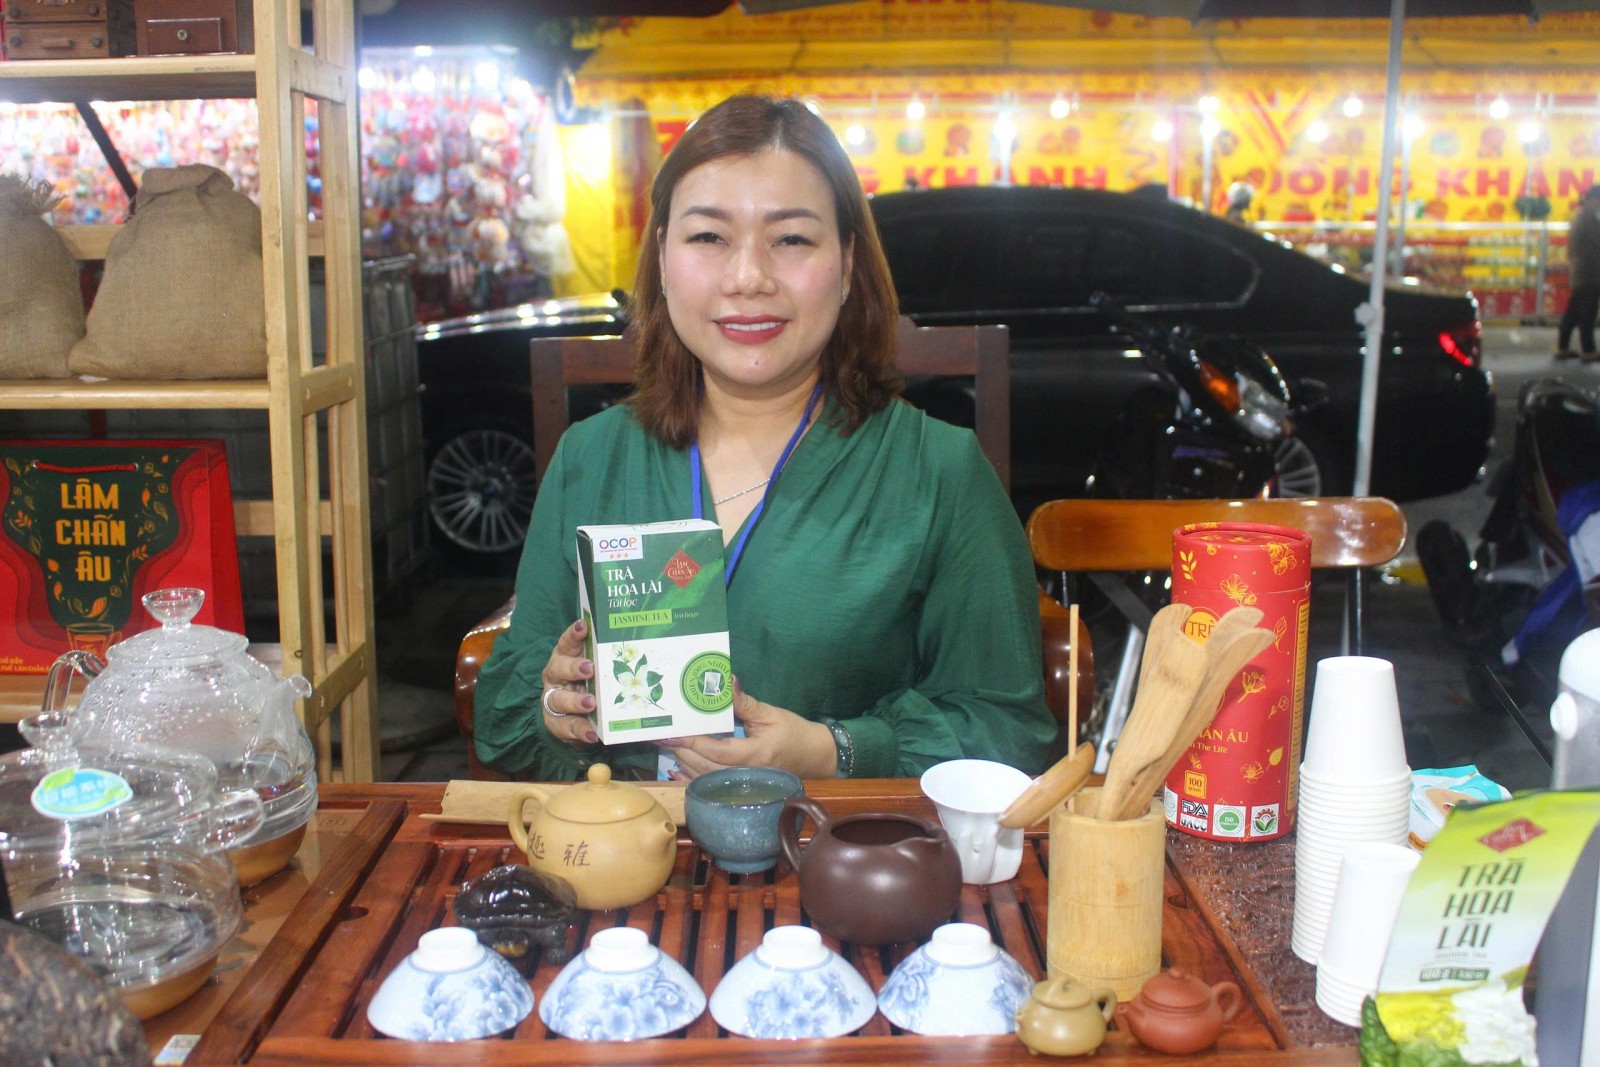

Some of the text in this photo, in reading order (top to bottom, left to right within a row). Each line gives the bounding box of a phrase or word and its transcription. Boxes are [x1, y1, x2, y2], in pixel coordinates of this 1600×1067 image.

[599, 536, 637, 549] OCOP
[605, 565, 634, 581] TRÀ
[607, 579, 663, 597] HOA LÀI
[613, 612, 669, 625] JASMINE TEA
[1226, 728, 1249, 744] ÂU
[1197, 741, 1212, 752] The
[1213, 744, 1228, 754] Life
[1189, 777, 1203, 788] 100
[1182, 801, 1208, 818] FDA
[1442, 889, 1514, 918] HOA
